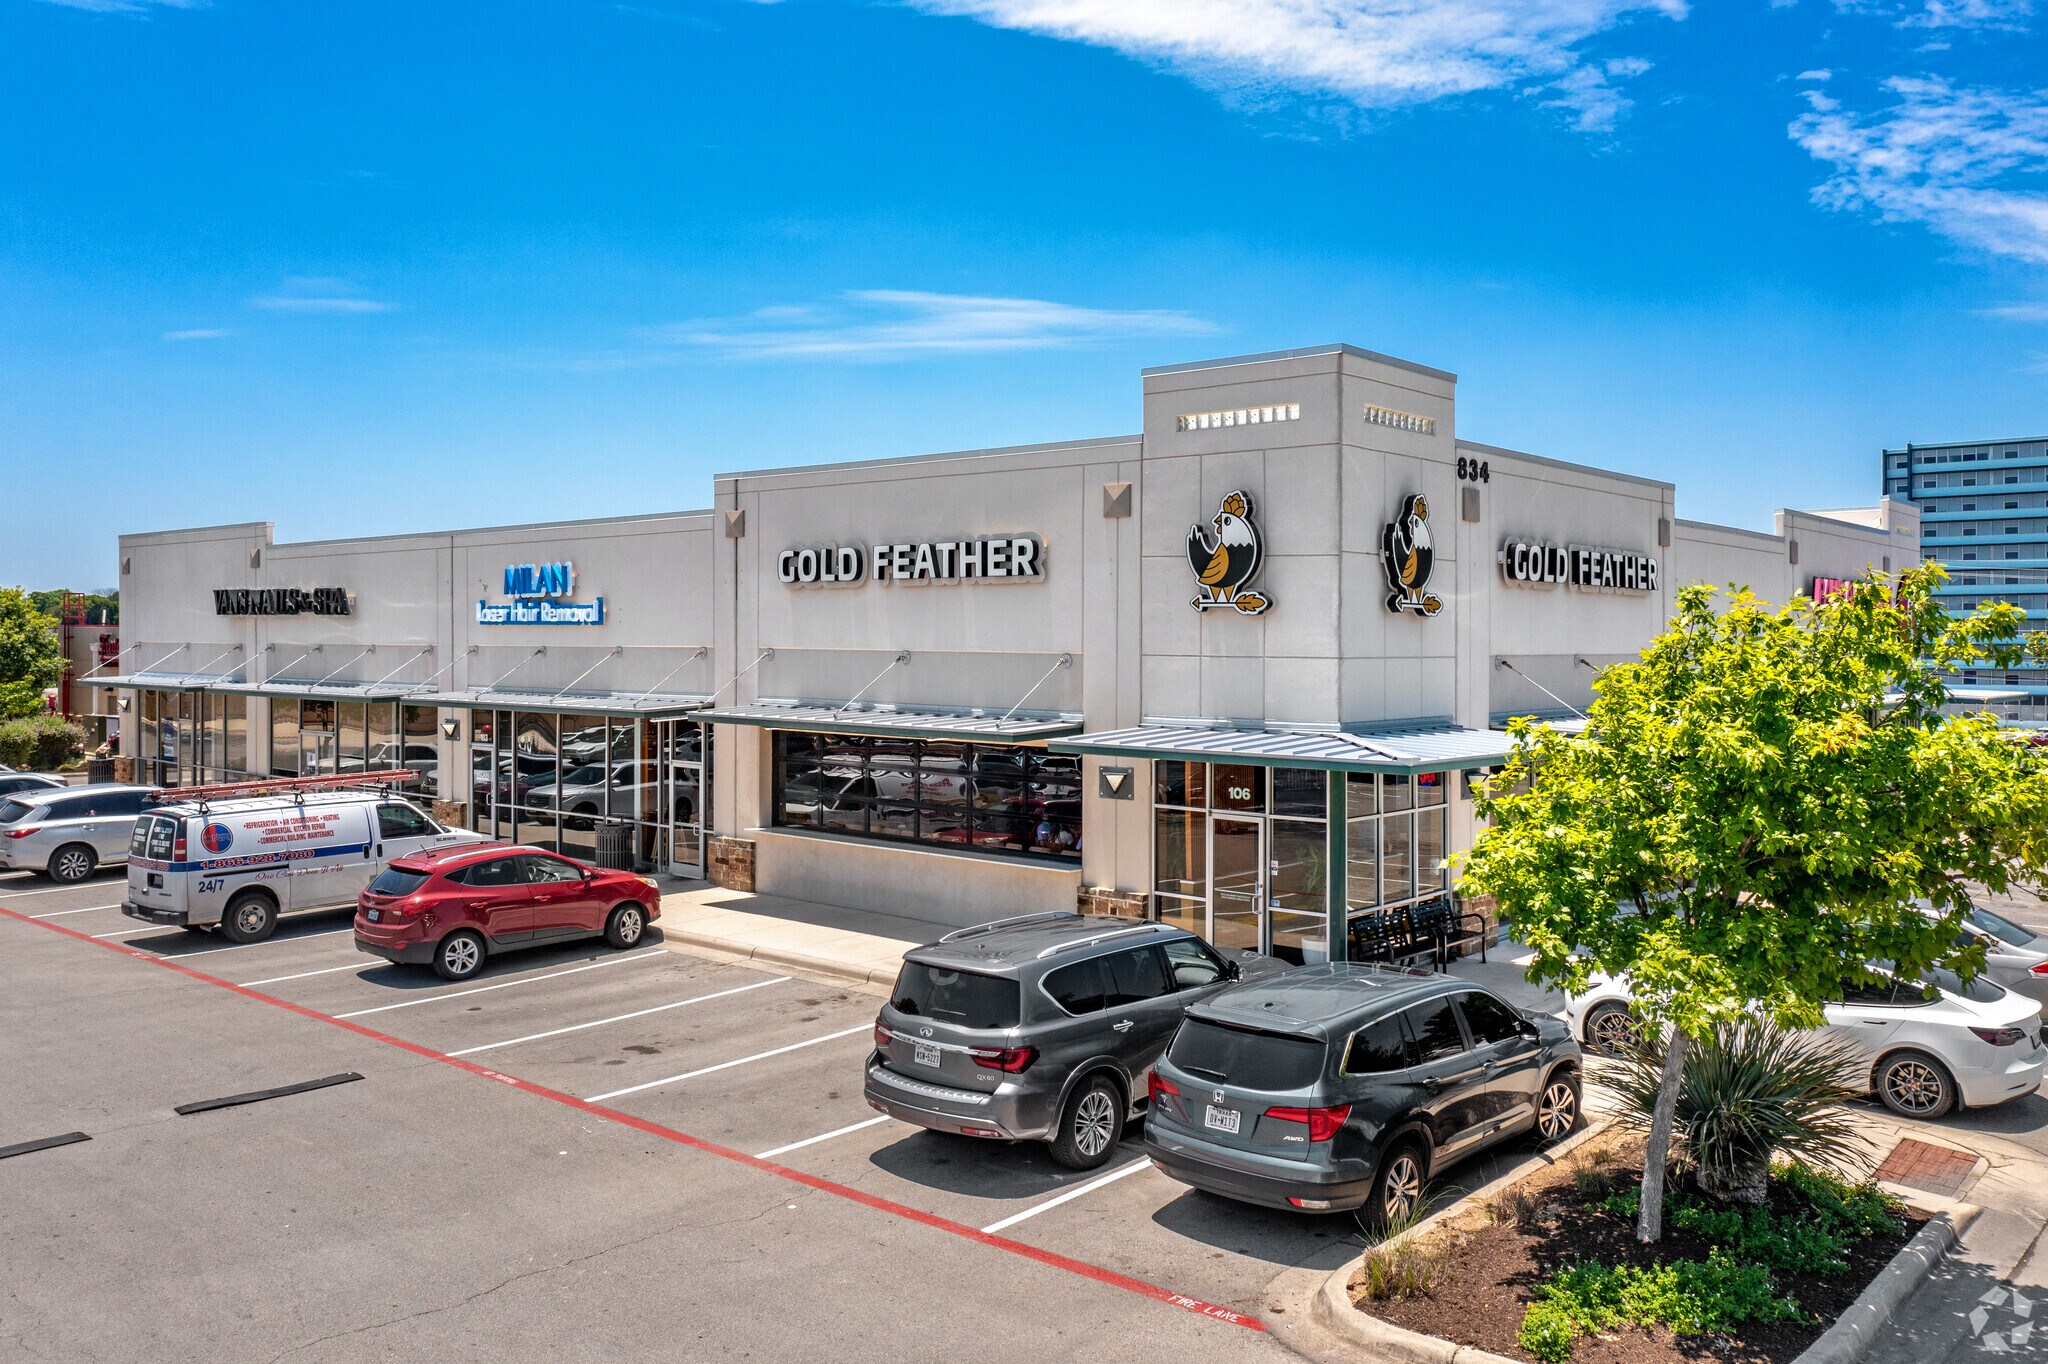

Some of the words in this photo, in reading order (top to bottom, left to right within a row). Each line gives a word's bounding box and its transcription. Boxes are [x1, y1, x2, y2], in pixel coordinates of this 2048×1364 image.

[1457, 456, 1490, 484] 834
[777, 547, 863, 584] GOLD
[872, 538, 1040, 580] FEATHER
[1507, 542, 1569, 584] GOLD
[1573, 550, 1659, 590] FEATHER
[503, 562, 572, 598] MILAN
[313, 586, 350, 615] SPA
[475, 600, 511, 625] Laser
[510, 600, 541, 625] Hair
[540, 597, 604, 625] Removal
[1228, 786, 1251, 800] 106
[246, 819, 278, 829] REFRIGERATION
[323, 813, 340, 821] HEATING
[265, 826, 292, 836] COMMERCIAL
[312, 822, 326, 831] REPAIR
[260, 835, 287, 845] COMMERCIAL
[307, 830, 334, 840] MAINTENANCE
[200, 849, 315, 870] 1-866-928-7080
[198, 879, 225, 893] 24/7
[1216, 1109, 1232, 1117] TEXAS
[1167, 1292, 1202, 1309] FIRE
[1203, 1306, 1244, 1323] LANE
